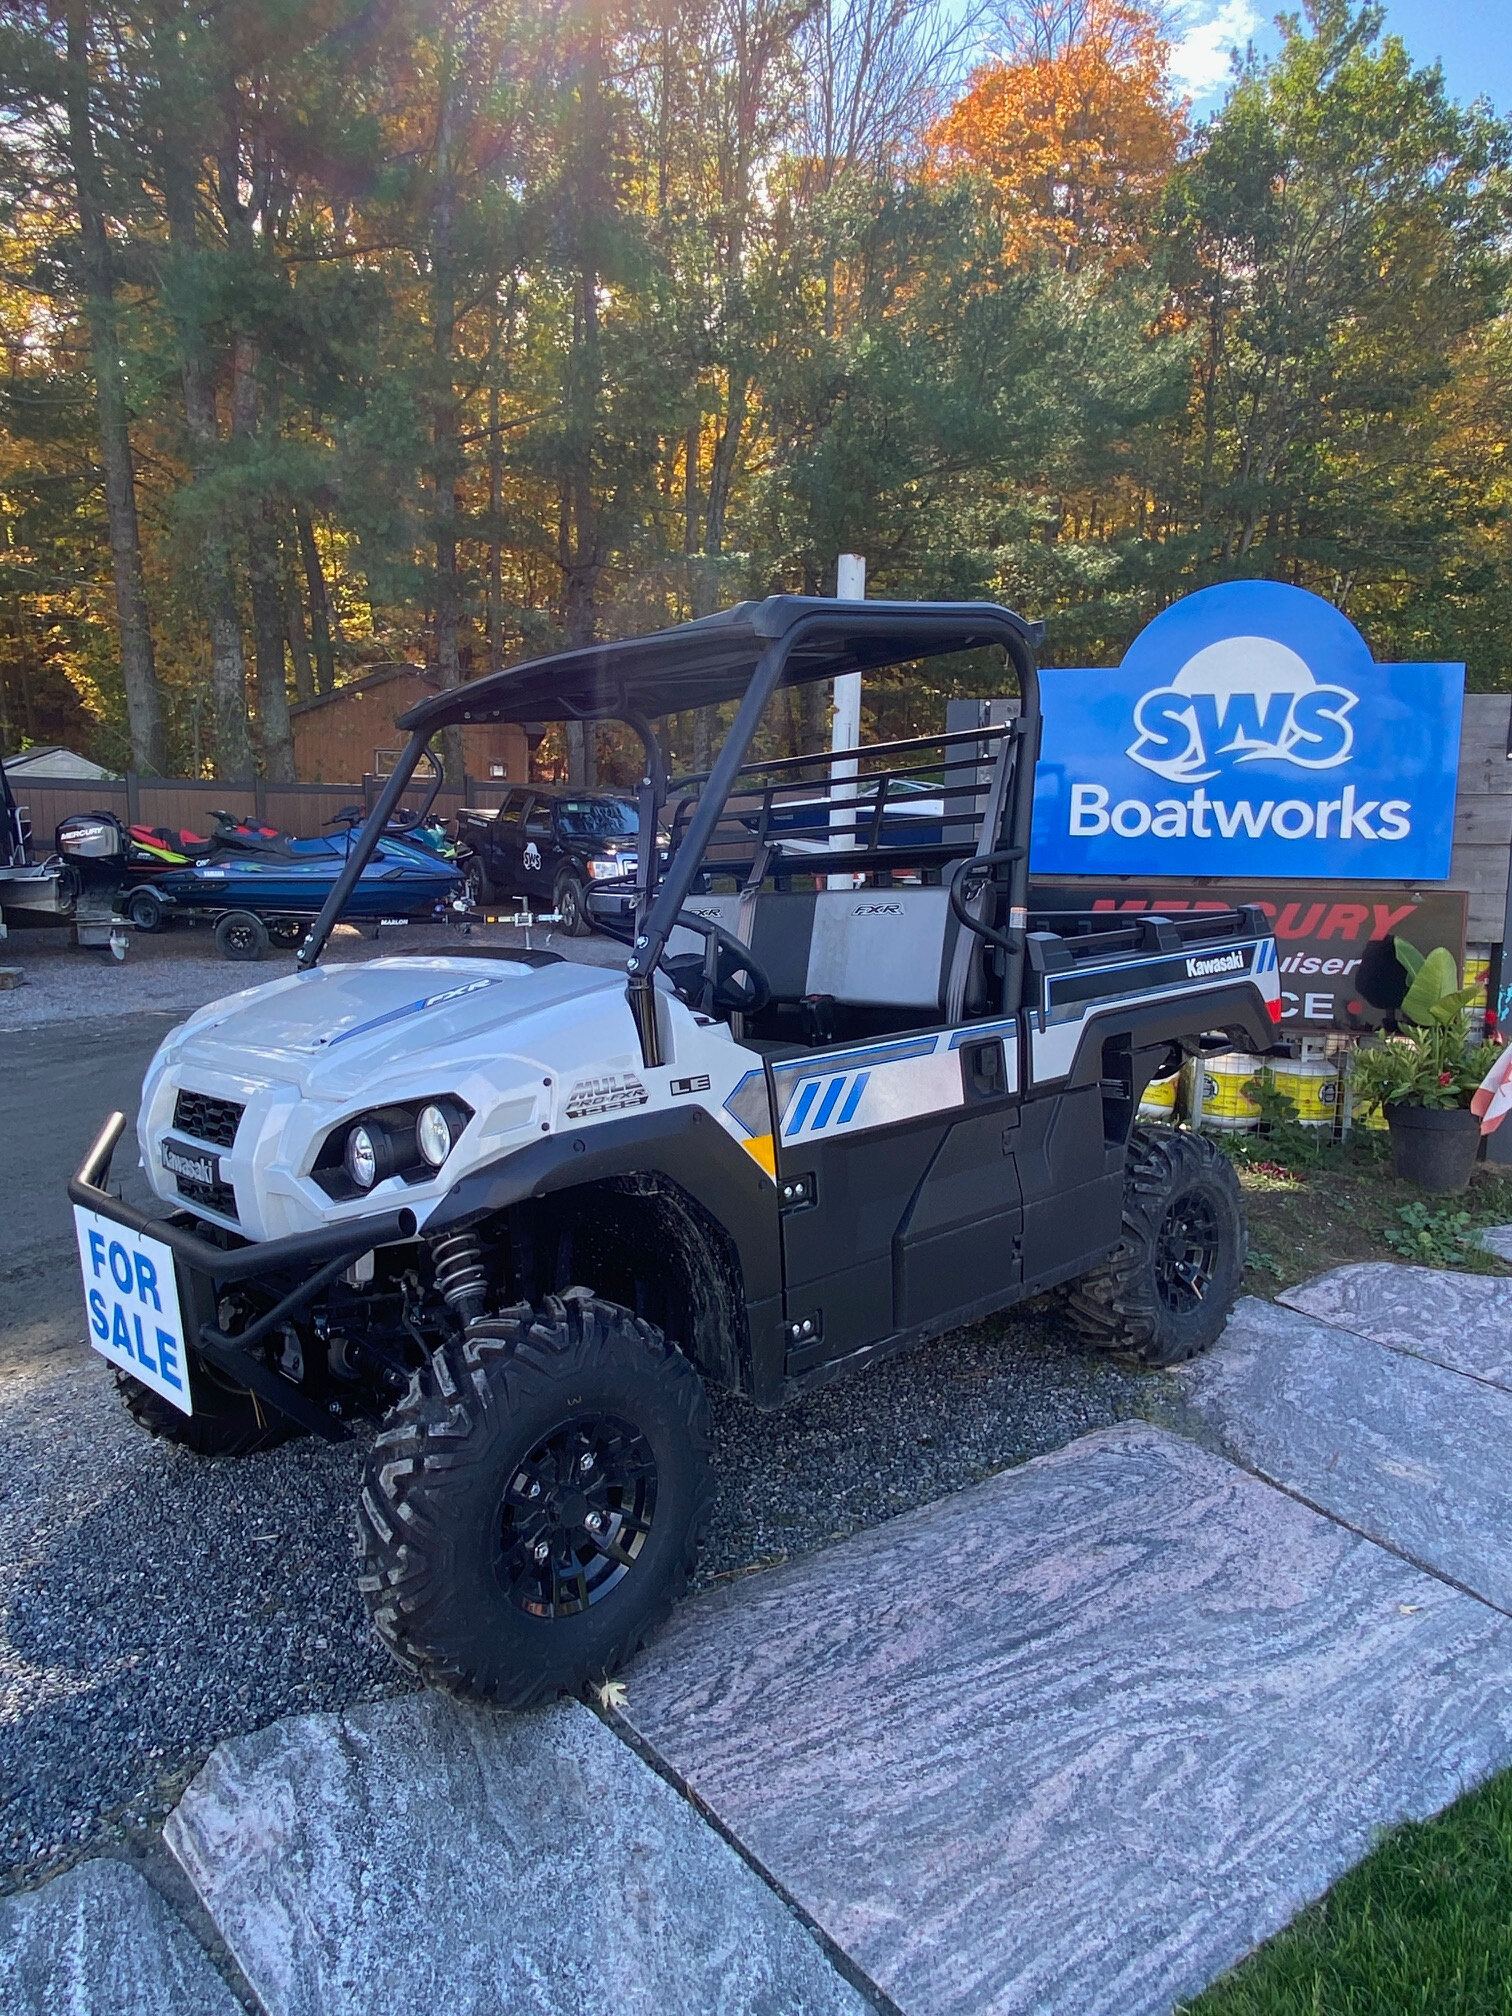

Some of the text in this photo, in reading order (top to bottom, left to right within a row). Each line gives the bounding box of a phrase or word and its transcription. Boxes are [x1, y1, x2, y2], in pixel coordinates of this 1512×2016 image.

[1126, 684, 1360, 783] SWS
[1069, 783, 1412, 841] Boatworks
[61, 827, 104, 840] MERCURY
[523, 850, 542, 870] SWS
[381, 918, 409, 926] MARLON
[853, 904, 902, 915] FXR
[1186, 951, 1243, 978] Kawasaki
[426, 978, 490, 1007] FXR
[570, 1073, 643, 1101] MULE
[671, 1076, 710, 1095] LE
[162, 1143, 213, 1184] Kawasaki
[88, 1229, 162, 1314] FOR
[89, 1288, 183, 1393] SALE
